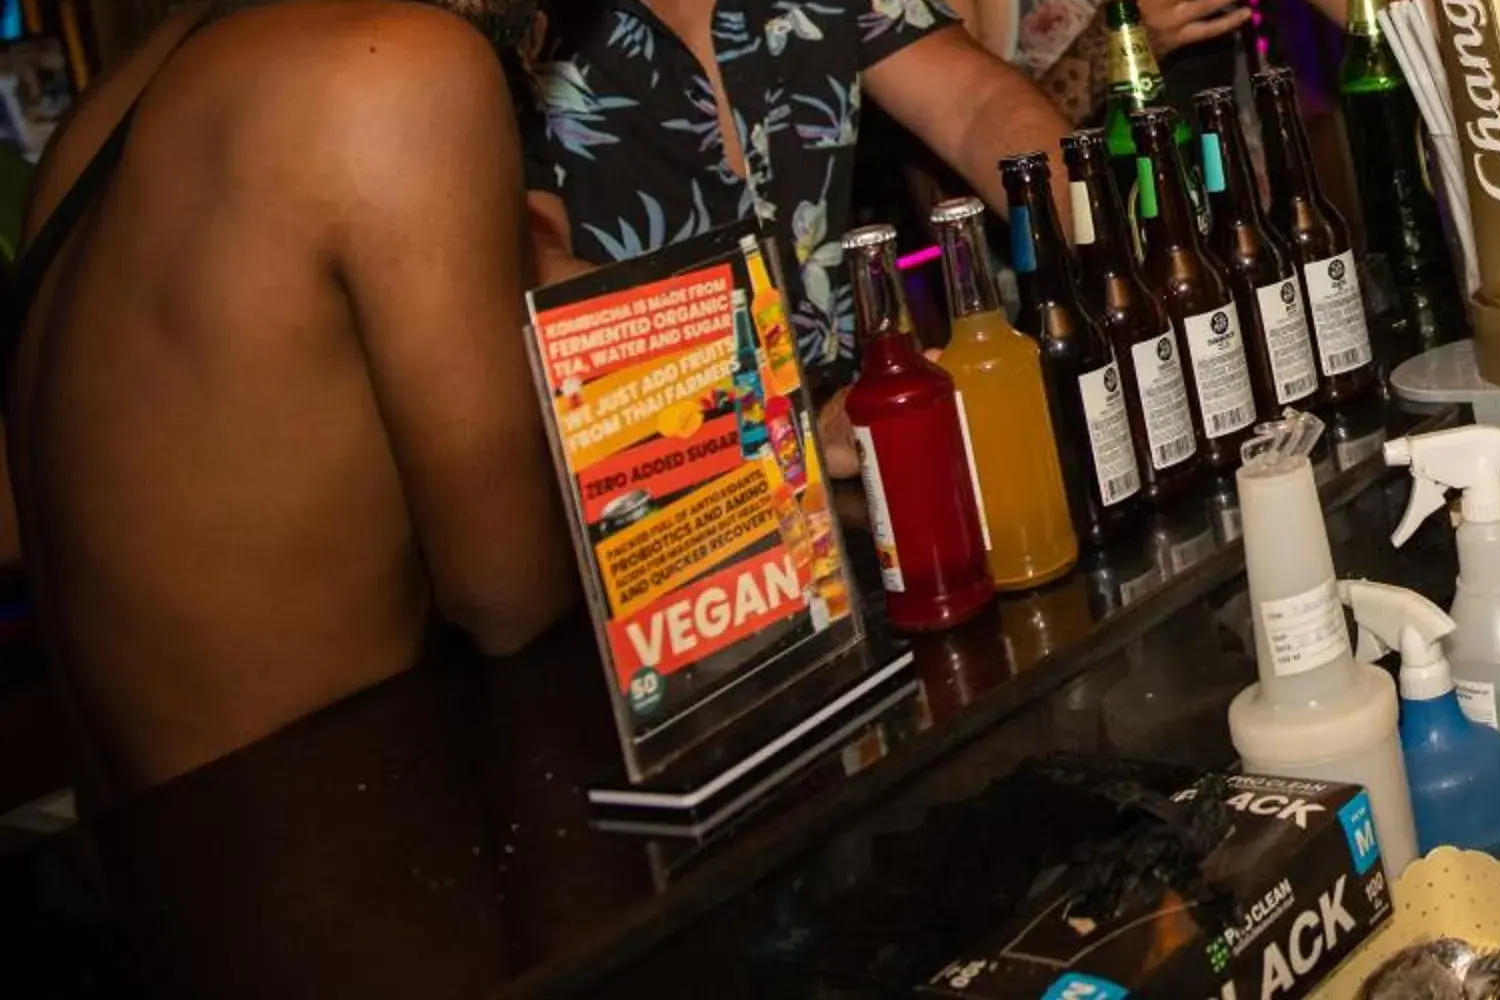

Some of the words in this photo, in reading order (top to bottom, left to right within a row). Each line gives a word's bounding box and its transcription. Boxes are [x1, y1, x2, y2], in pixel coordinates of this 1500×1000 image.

[544, 303, 632, 338] KOMBUCHA
[632, 299, 647, 314] IS
[647, 289, 688, 311] MADE
[687, 278, 727, 299] FROM
[548, 317, 651, 358] FERMENTED
[653, 295, 729, 328] ORGANIC
[552, 357, 590, 378] TEA,
[590, 339, 648, 368] WATER
[648, 328, 681, 350] AND
[682, 313, 732, 340] SUGAR
[566, 403, 592, 431] WE
[596, 381, 641, 416] JUST
[642, 362, 680, 394] ADD
[678, 335, 736, 374] FRUITS
[566, 414, 621, 450] FROM
[621, 393, 665, 426] THAI
[664, 360, 741, 405] FARMERS
[585, 471, 627, 499] ZERO
[631, 451, 685, 481] ADDED
[687, 431, 739, 462] SUGAR
[610, 521, 692, 576] PROBIOTICS
[693, 505, 723, 528] AND
[724, 480, 770, 511] AMINO
[619, 579, 650, 605] AND
[651, 547, 709, 585] QUICKER
[709, 508, 775, 549] RECOVERY
[625, 553, 800, 666] VEGAN
[1266, 778, 1327, 792] CLEAN
[1354, 819, 1374, 858] M
[1251, 877, 1293, 922] CLEAN
